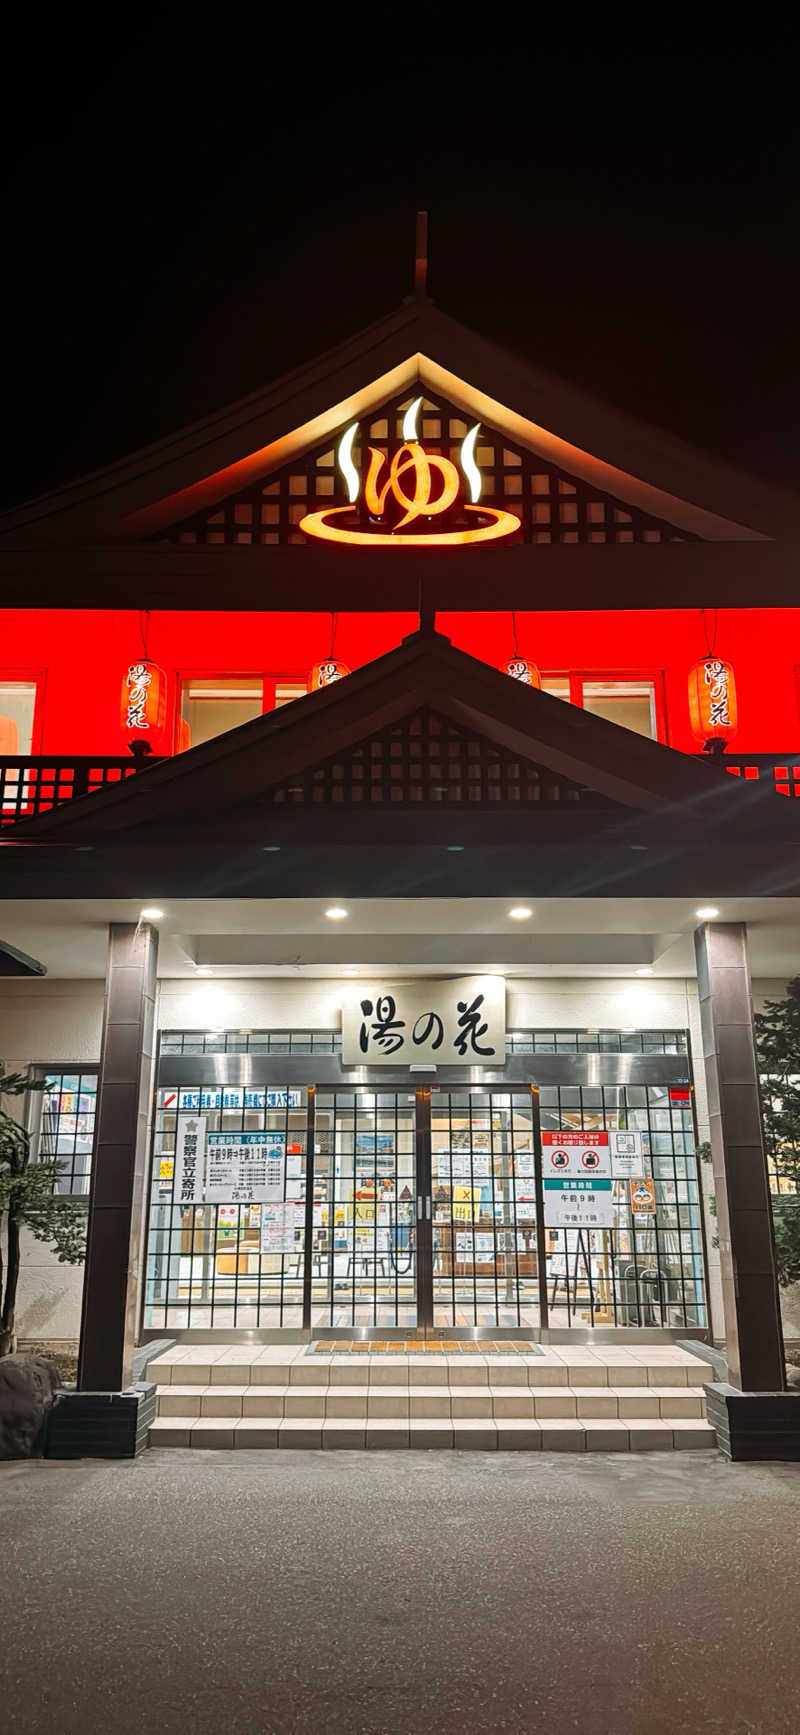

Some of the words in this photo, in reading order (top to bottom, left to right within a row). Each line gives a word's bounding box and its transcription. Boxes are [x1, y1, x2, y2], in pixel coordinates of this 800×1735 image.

[365, 443, 460, 531] ゆ
[126, 664, 152, 728] 湯の花
[704, 661, 732, 726] 湯の花
[359, 994, 496, 1056] 湯の花
[181, 1134, 198, 1201] 警察官立寄所
[561, 1194, 596, 1203] 午前9時
[562, 1181, 593, 1189] 営業時間
[564, 1214, 598, 1222] 午後11時
